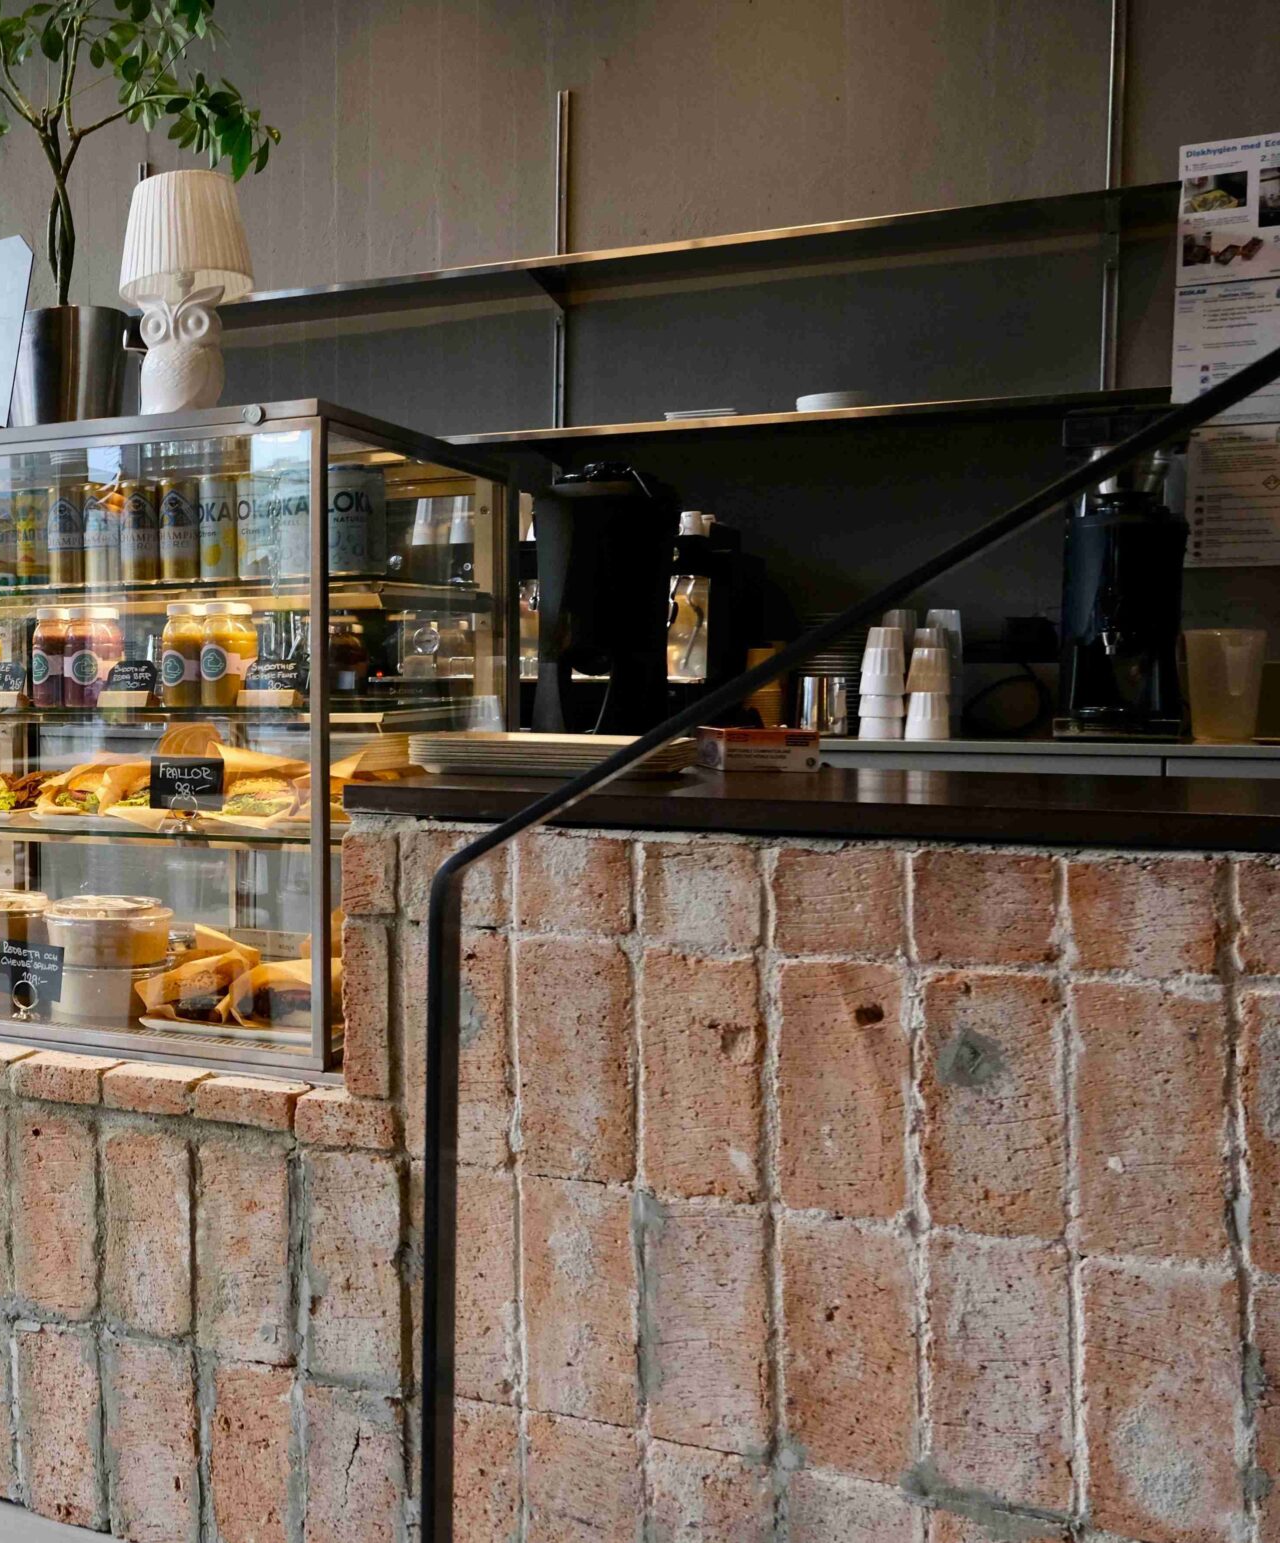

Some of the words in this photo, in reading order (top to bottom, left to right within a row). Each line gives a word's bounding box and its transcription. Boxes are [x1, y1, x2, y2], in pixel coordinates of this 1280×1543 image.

[1186, 143, 1237, 159] Diskhygien
[1240, 141, 1261, 151] med
[199, 501, 233, 522] OKA
[267, 495, 309, 518] OKA
[251, 662, 297, 671] SMOOTHIE
[159, 762, 214, 780] FRALLOR
[43, 952, 58, 961] OCH
